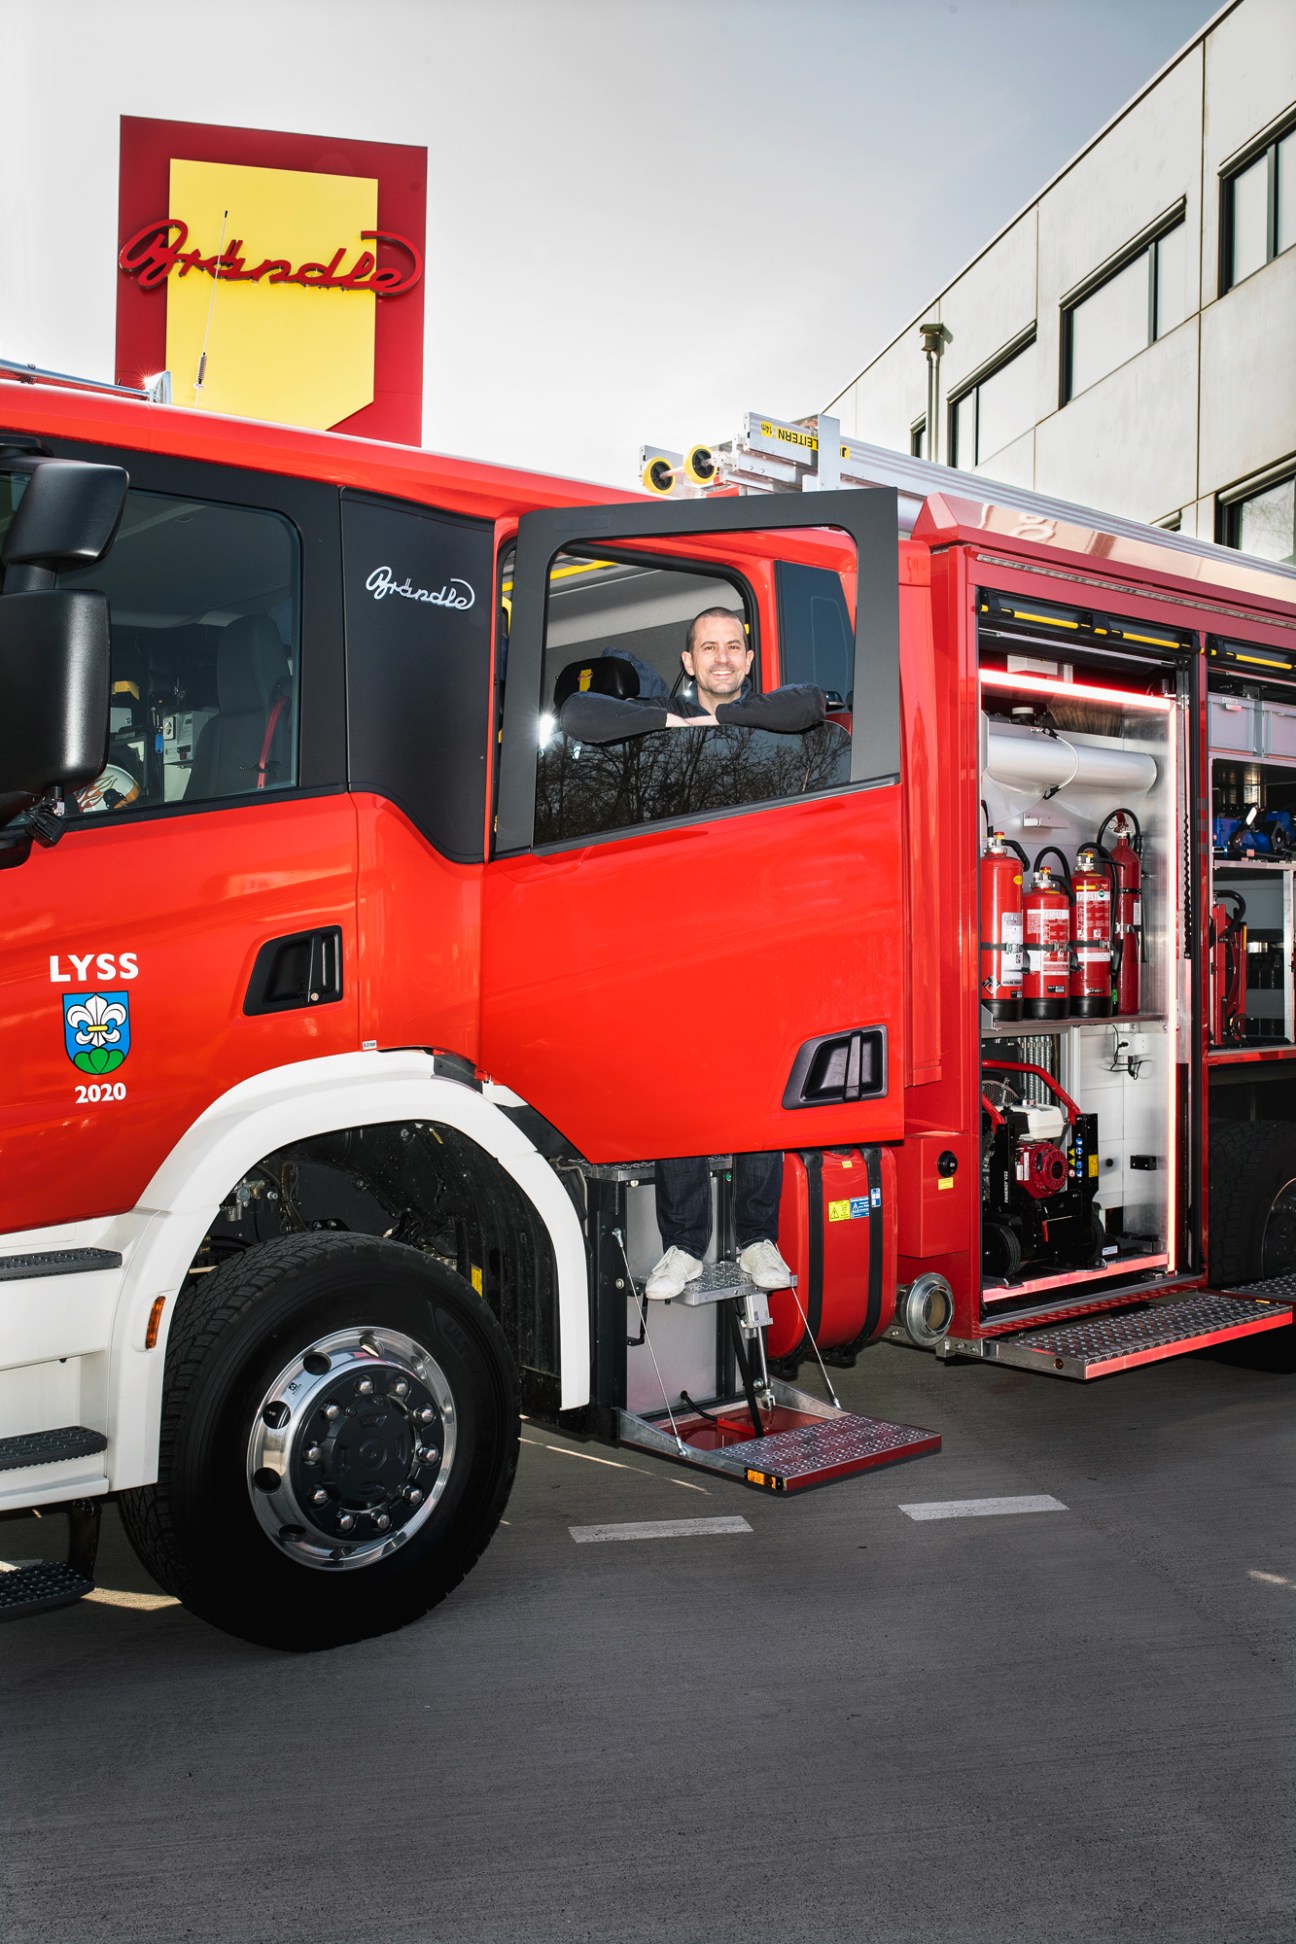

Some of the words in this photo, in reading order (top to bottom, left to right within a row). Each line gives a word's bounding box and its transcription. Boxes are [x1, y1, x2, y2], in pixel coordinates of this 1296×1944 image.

[778, 428, 819, 450] LEITERN
[49, 952, 139, 983] LYSS
[74, 1082, 127, 1104] 2020
